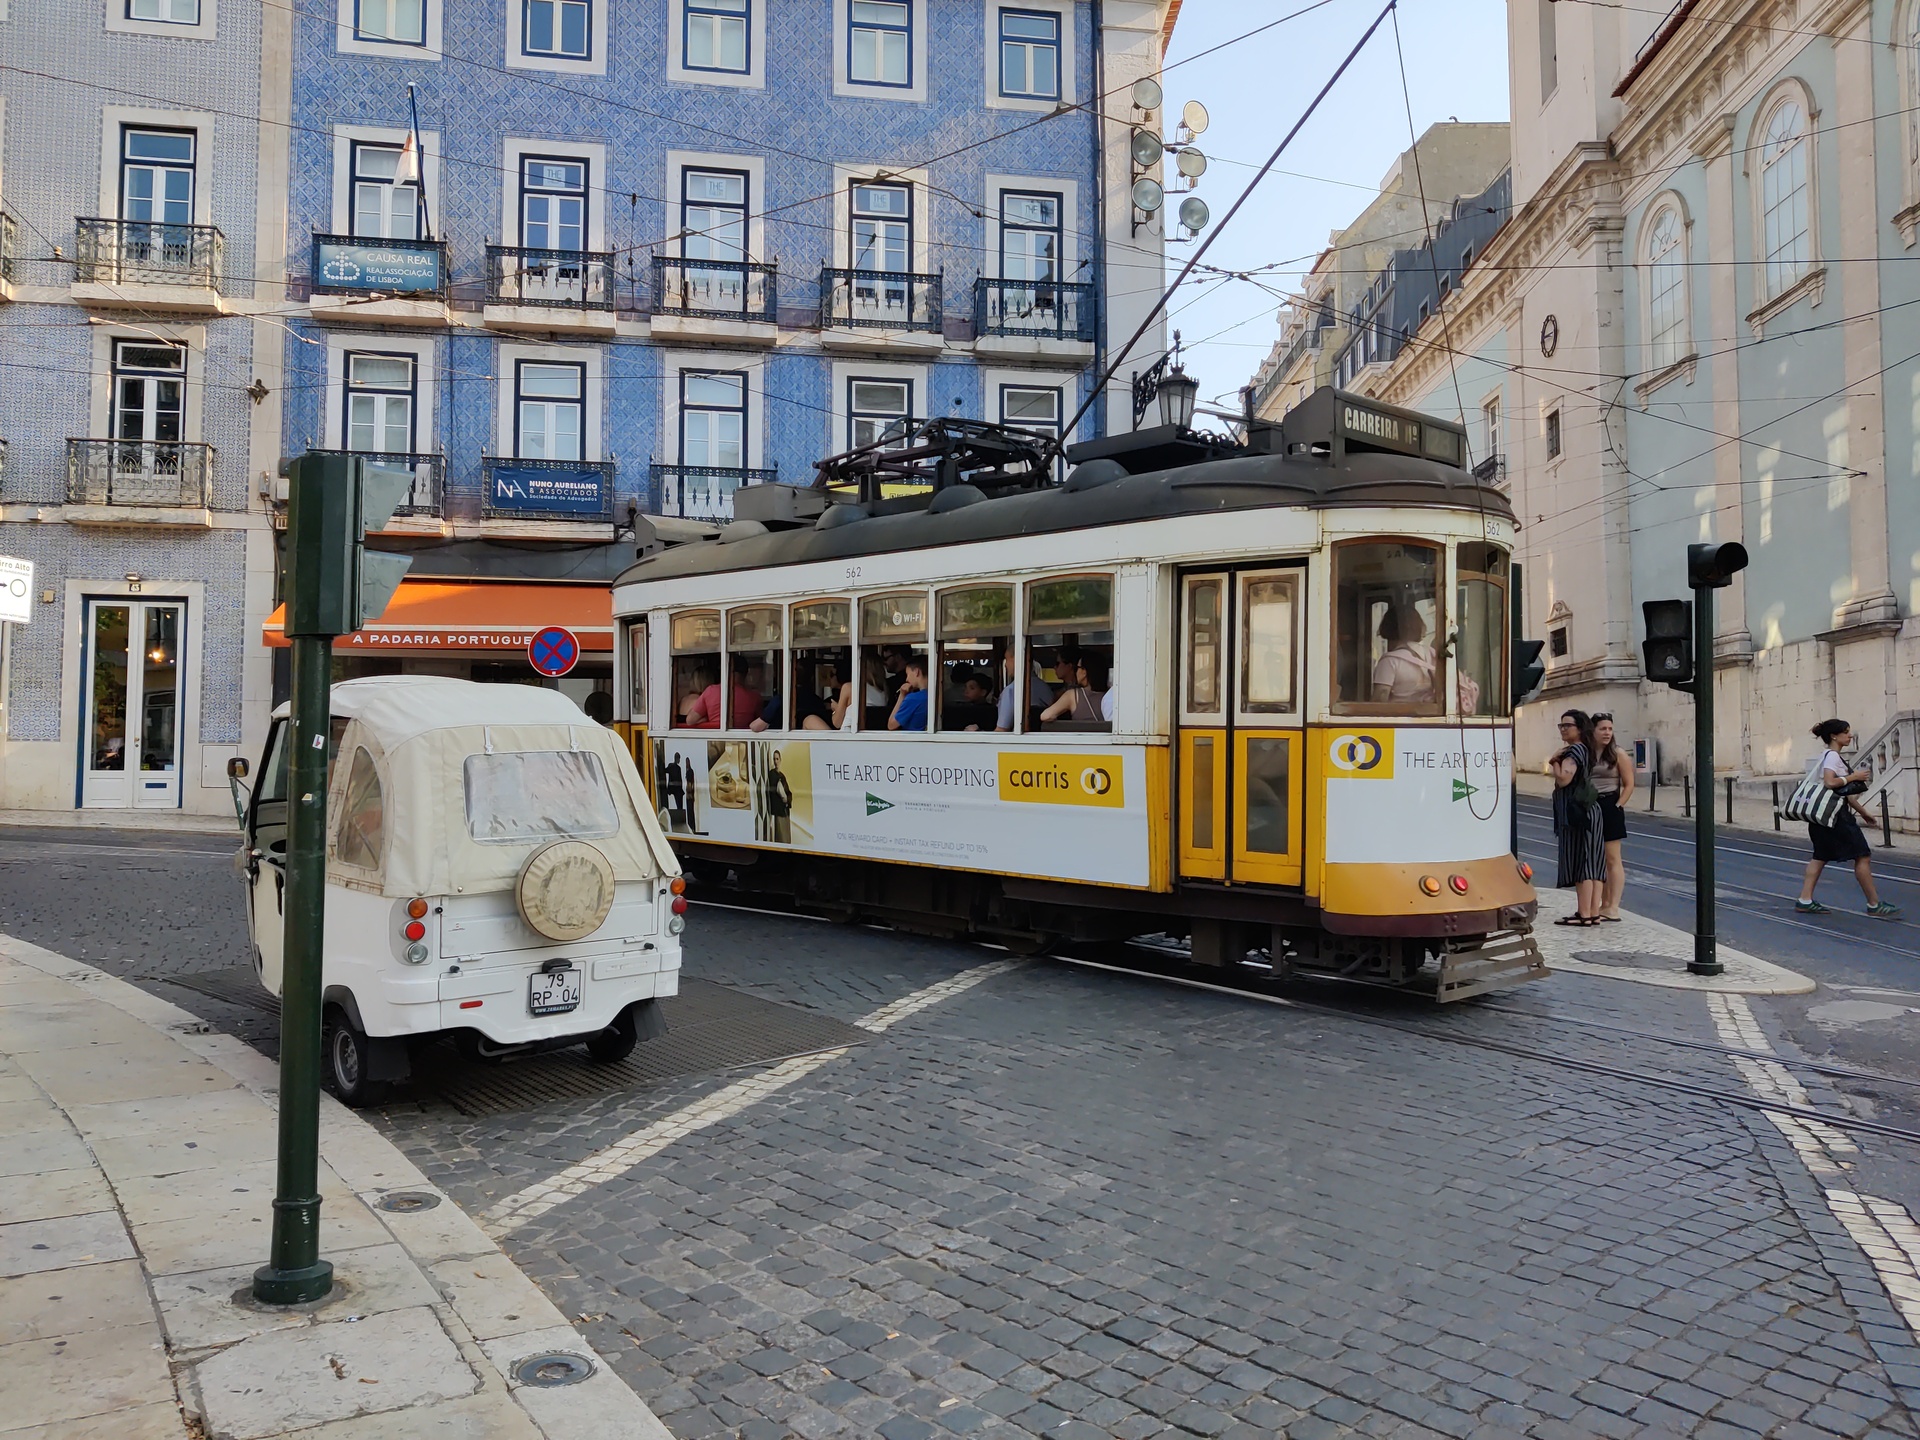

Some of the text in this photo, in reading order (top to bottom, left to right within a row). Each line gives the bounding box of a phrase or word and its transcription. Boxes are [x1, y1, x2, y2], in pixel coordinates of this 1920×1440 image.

[547, 169, 562, 180] THE
[708, 181, 724, 191] THE
[873, 194, 886, 203] THE
[366, 253, 434, 266] CAUSA REAL
[366, 266, 434, 277] REAL ASSOCIAÇÃO
[378, 276, 404, 284] LISBOA
[1344, 406, 1399, 441] CARREIRA
[529, 480, 598, 490] NUNO AURELIANO
[1486, 521, 1500, 536] 562
[15, 562, 30, 572] Alto
[845, 566, 862, 579] 562
[903, 613, 922, 623] WI-FI
[352, 634, 364, 644] A
[370, 634, 441, 644] PADARIA
[1402, 752, 1436, 768] THE
[1440, 752, 1471, 768] ART
[1474, 752, 1490, 768] OF
[826, 764, 996, 788] THE ART OF SHOPPING
[1009, 764, 1070, 790] carris
[836, 832, 847, 840] 10%
[848, 833, 871, 842] REWARD
[872, 835, 888, 844] CARD
[894, 838, 917, 846] INSTANT
[918, 840, 929, 848] TAX
[930, 840, 954, 850] REFUND
[956, 842, 965, 850] UP
[966, 844, 975, 852] TO
[976, 844, 988, 854] 15%
[548, 974, 564, 988] 79
